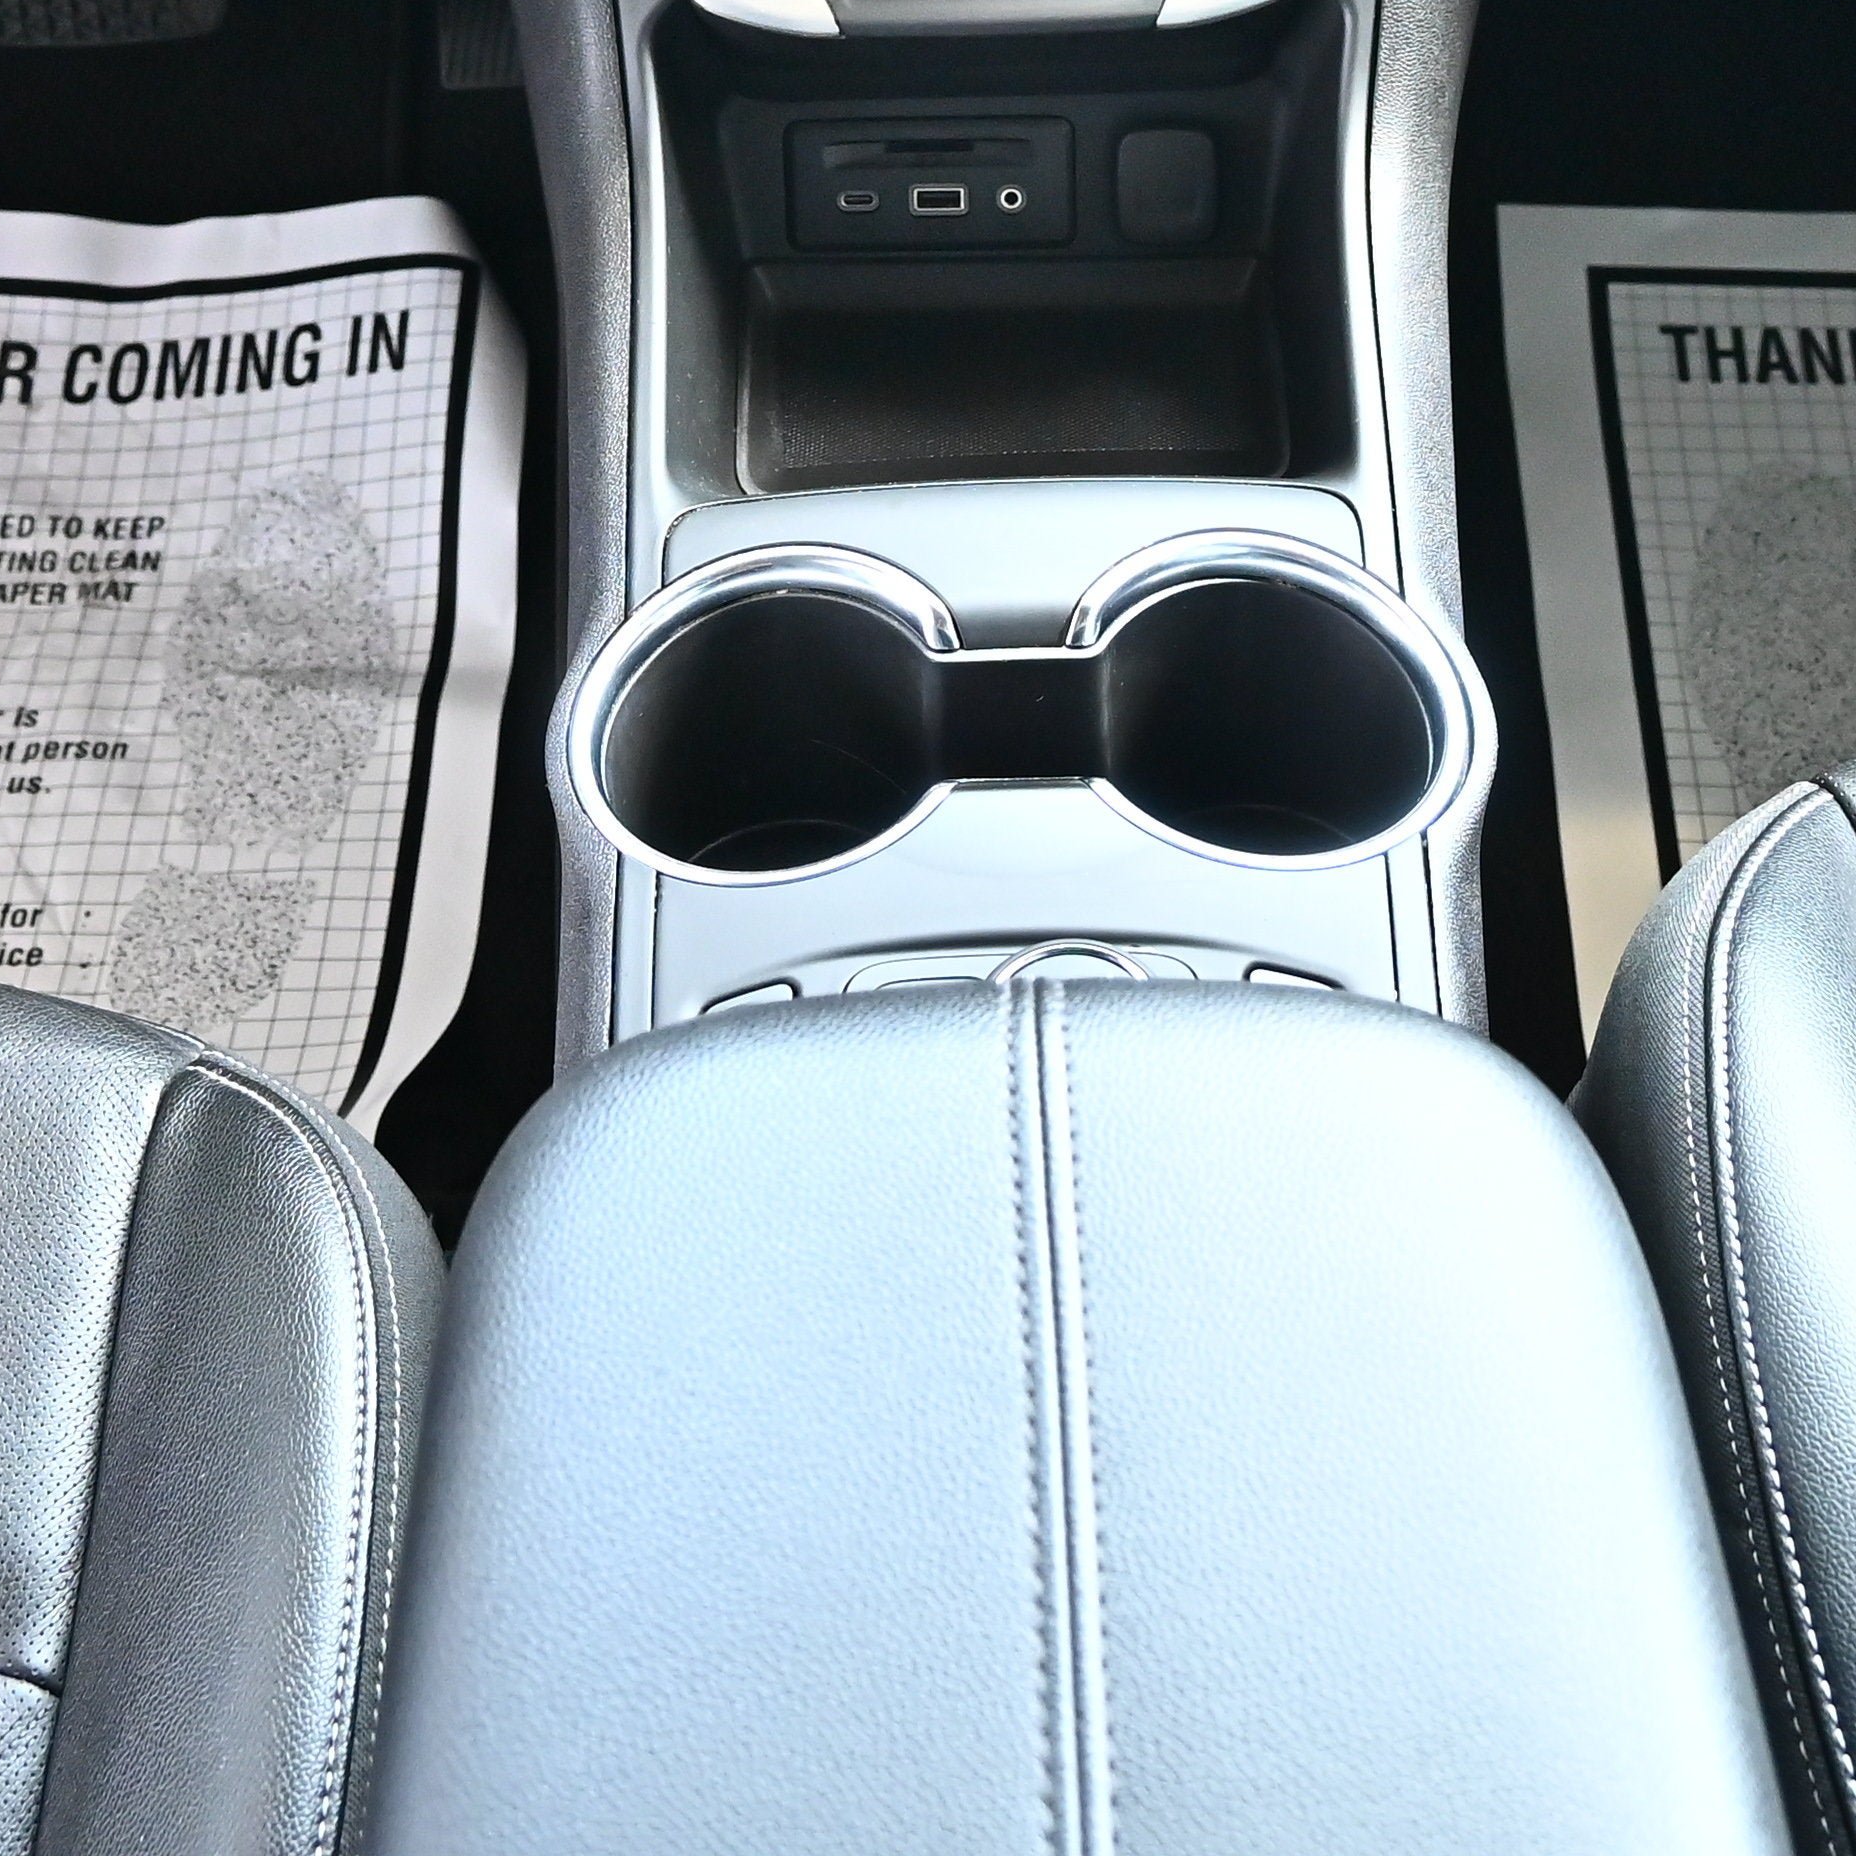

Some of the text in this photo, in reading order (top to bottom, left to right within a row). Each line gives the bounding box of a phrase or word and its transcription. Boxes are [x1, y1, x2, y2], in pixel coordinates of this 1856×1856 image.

[62, 323, 322, 405] COMING
[346, 308, 410, 373] IN
[49, 517, 82, 539] TO
[92, 516, 165, 539] KEEP
[68, 551, 161, 572] CLEAN
[13, 707, 39, 727] is
[22, 740, 128, 764] person
[6, 776, 51, 795] us.
